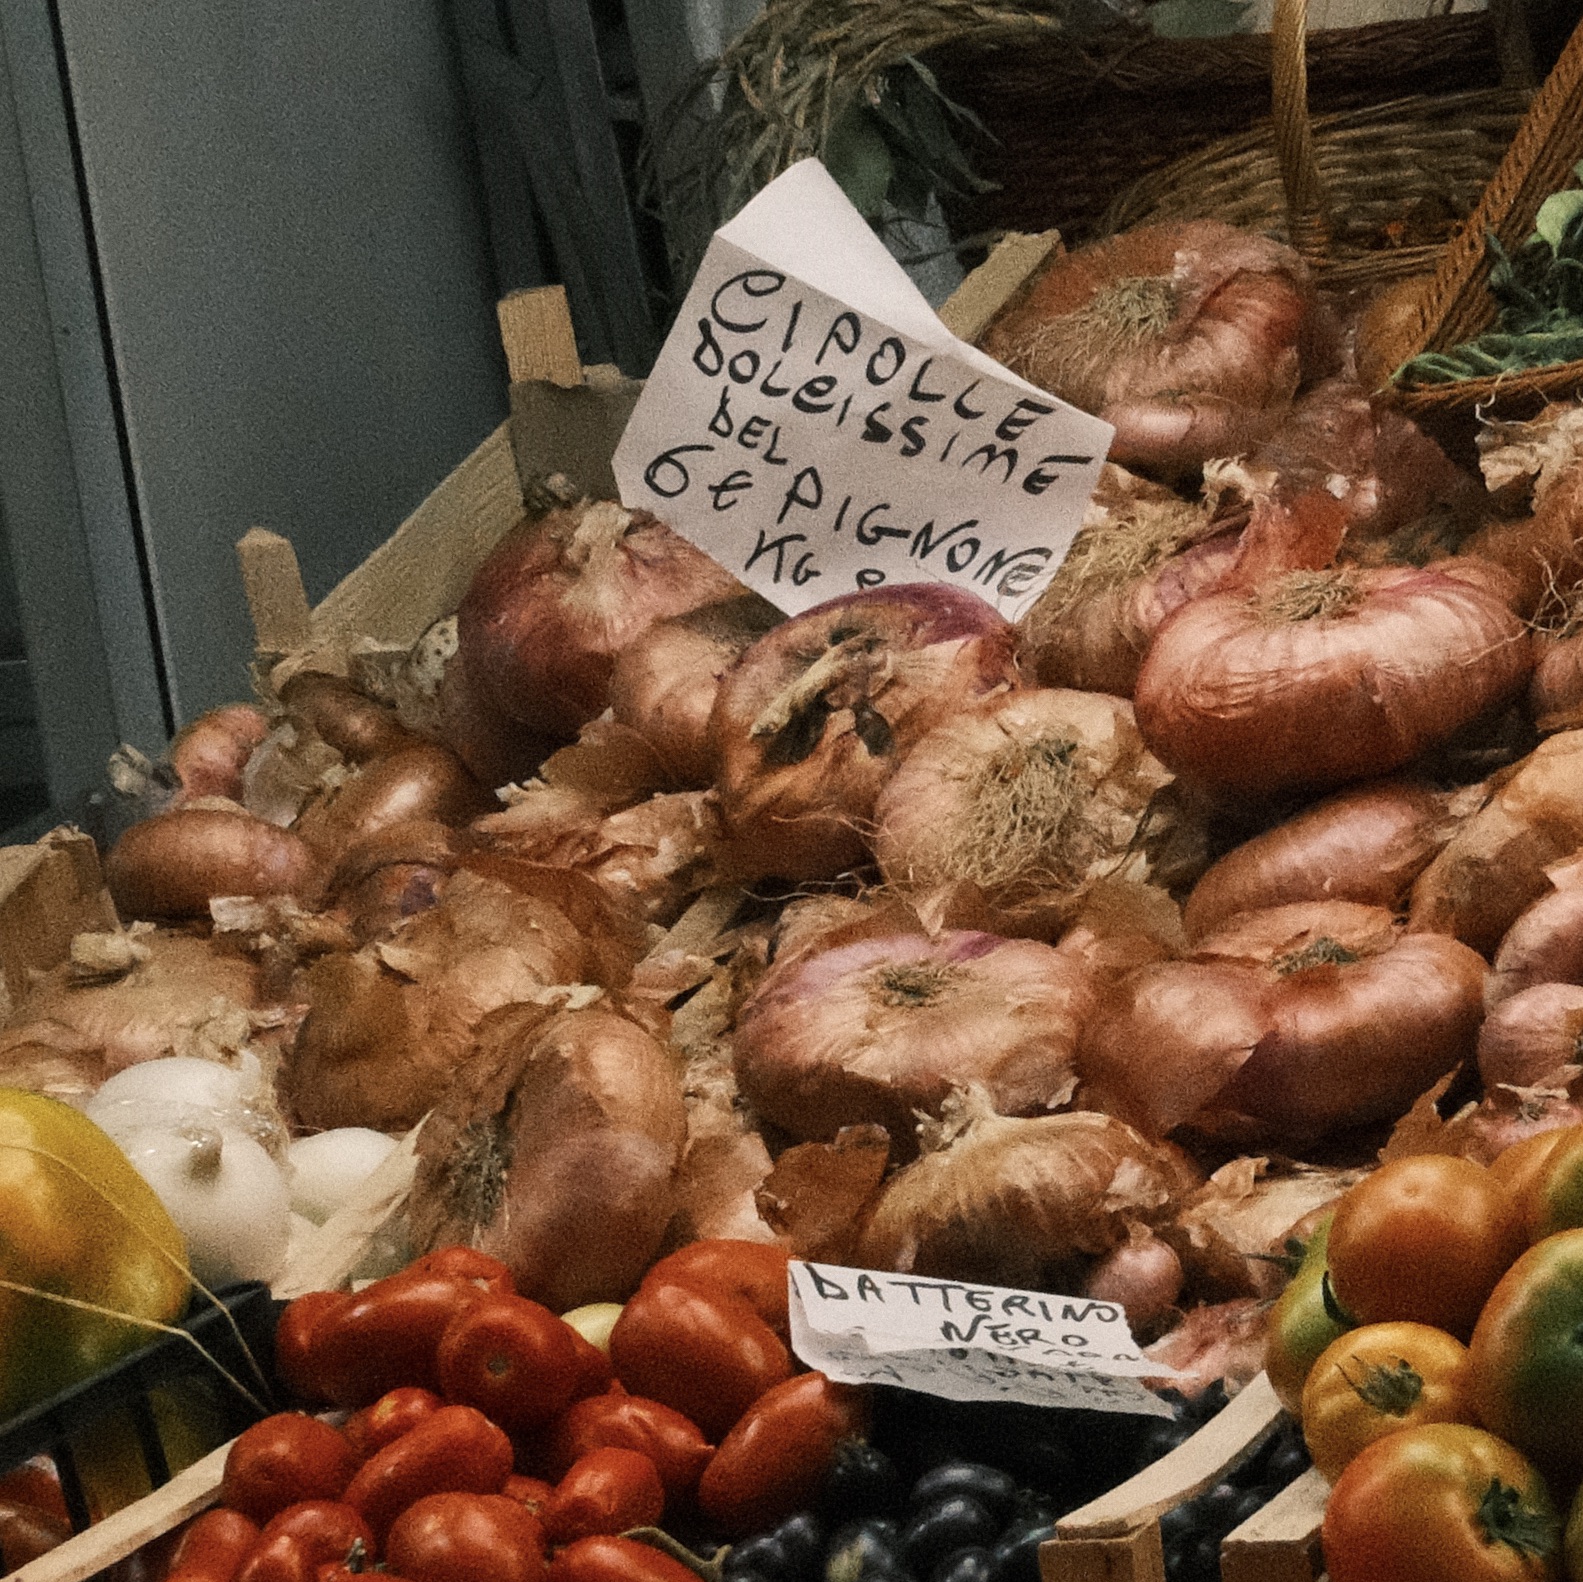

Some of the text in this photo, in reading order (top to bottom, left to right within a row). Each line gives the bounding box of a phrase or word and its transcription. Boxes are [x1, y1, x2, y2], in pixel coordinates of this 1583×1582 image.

[711, 269, 1055, 442] CIPOLLE
[708, 386, 788, 466] DEL
[777, 466, 1053, 597] PIGNONE
[803, 1262, 1120, 1324] DATTERINO
[940, 1314, 1090, 1347] NERO
